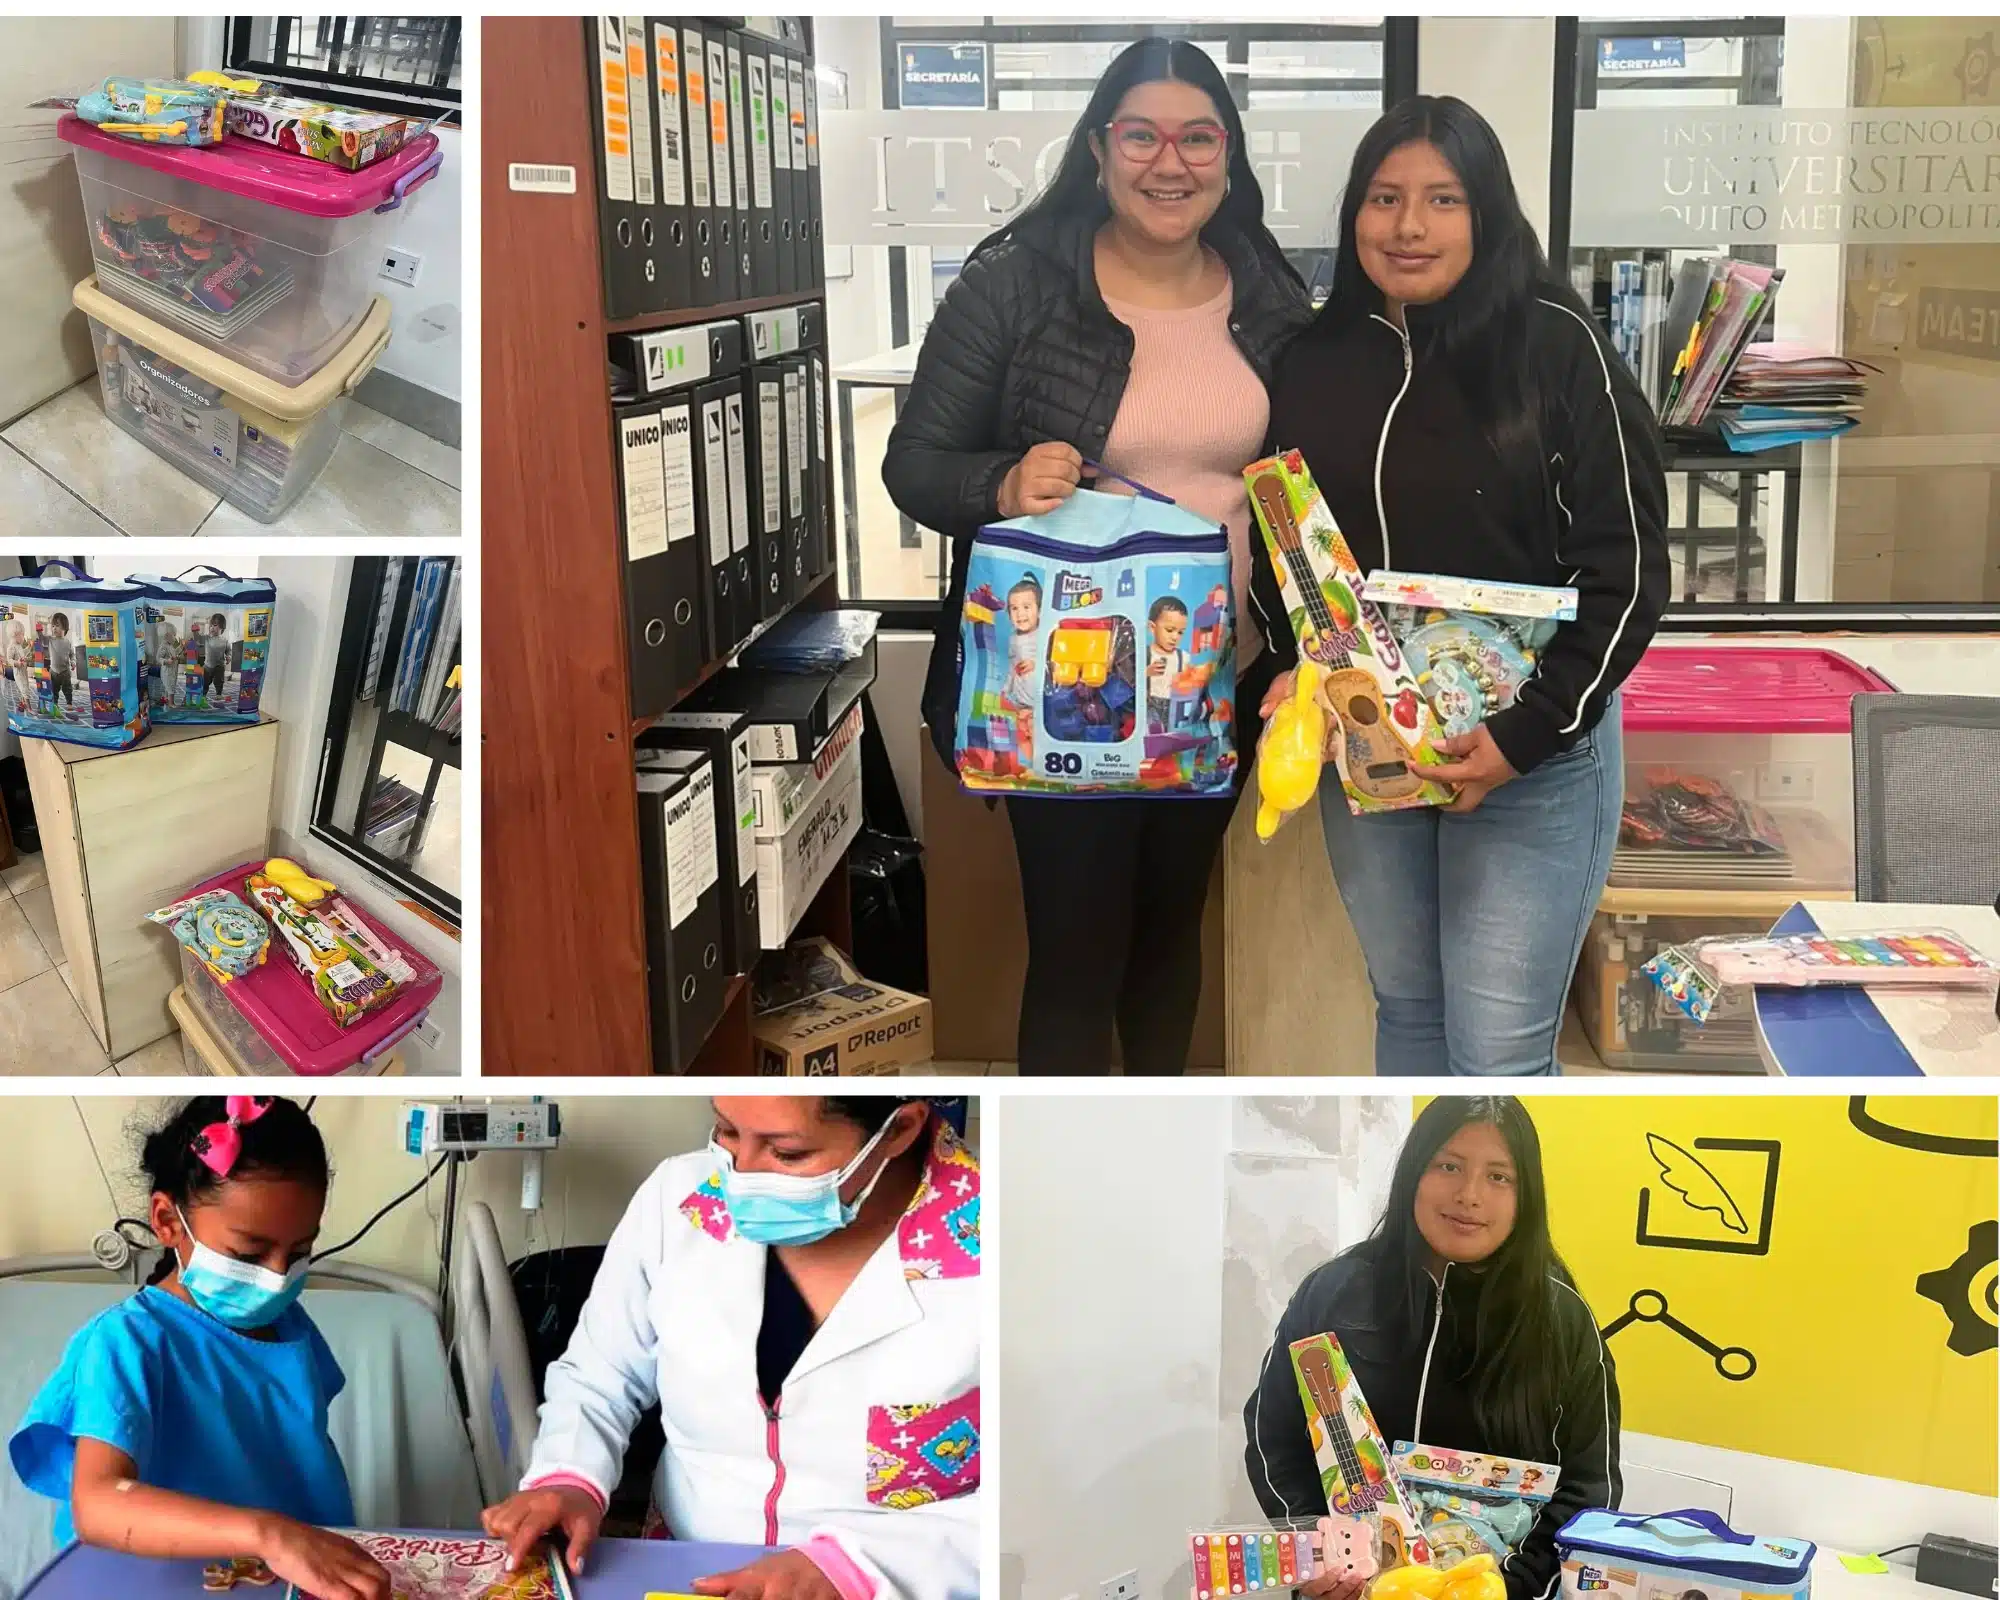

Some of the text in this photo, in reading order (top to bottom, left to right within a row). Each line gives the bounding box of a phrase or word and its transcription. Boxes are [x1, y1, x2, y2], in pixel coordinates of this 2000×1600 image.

[1603, 58, 1681, 70] SECRETARÍA
[905, 71, 980, 84] SECRETARÍA
[1780, 203, 2000, 231] METROPOLIT
[139, 360, 211, 407] Organizadores
[626, 426, 659, 448] UNICO
[1064, 578, 1090, 592] MEGA
[1044, 751, 1082, 774] 80
[865, 1015, 921, 1047] Report
[808, 1051, 836, 1076] A4
[366, 1536, 504, 1567] Barbie
[1195, 1553, 1207, 1562] Do
